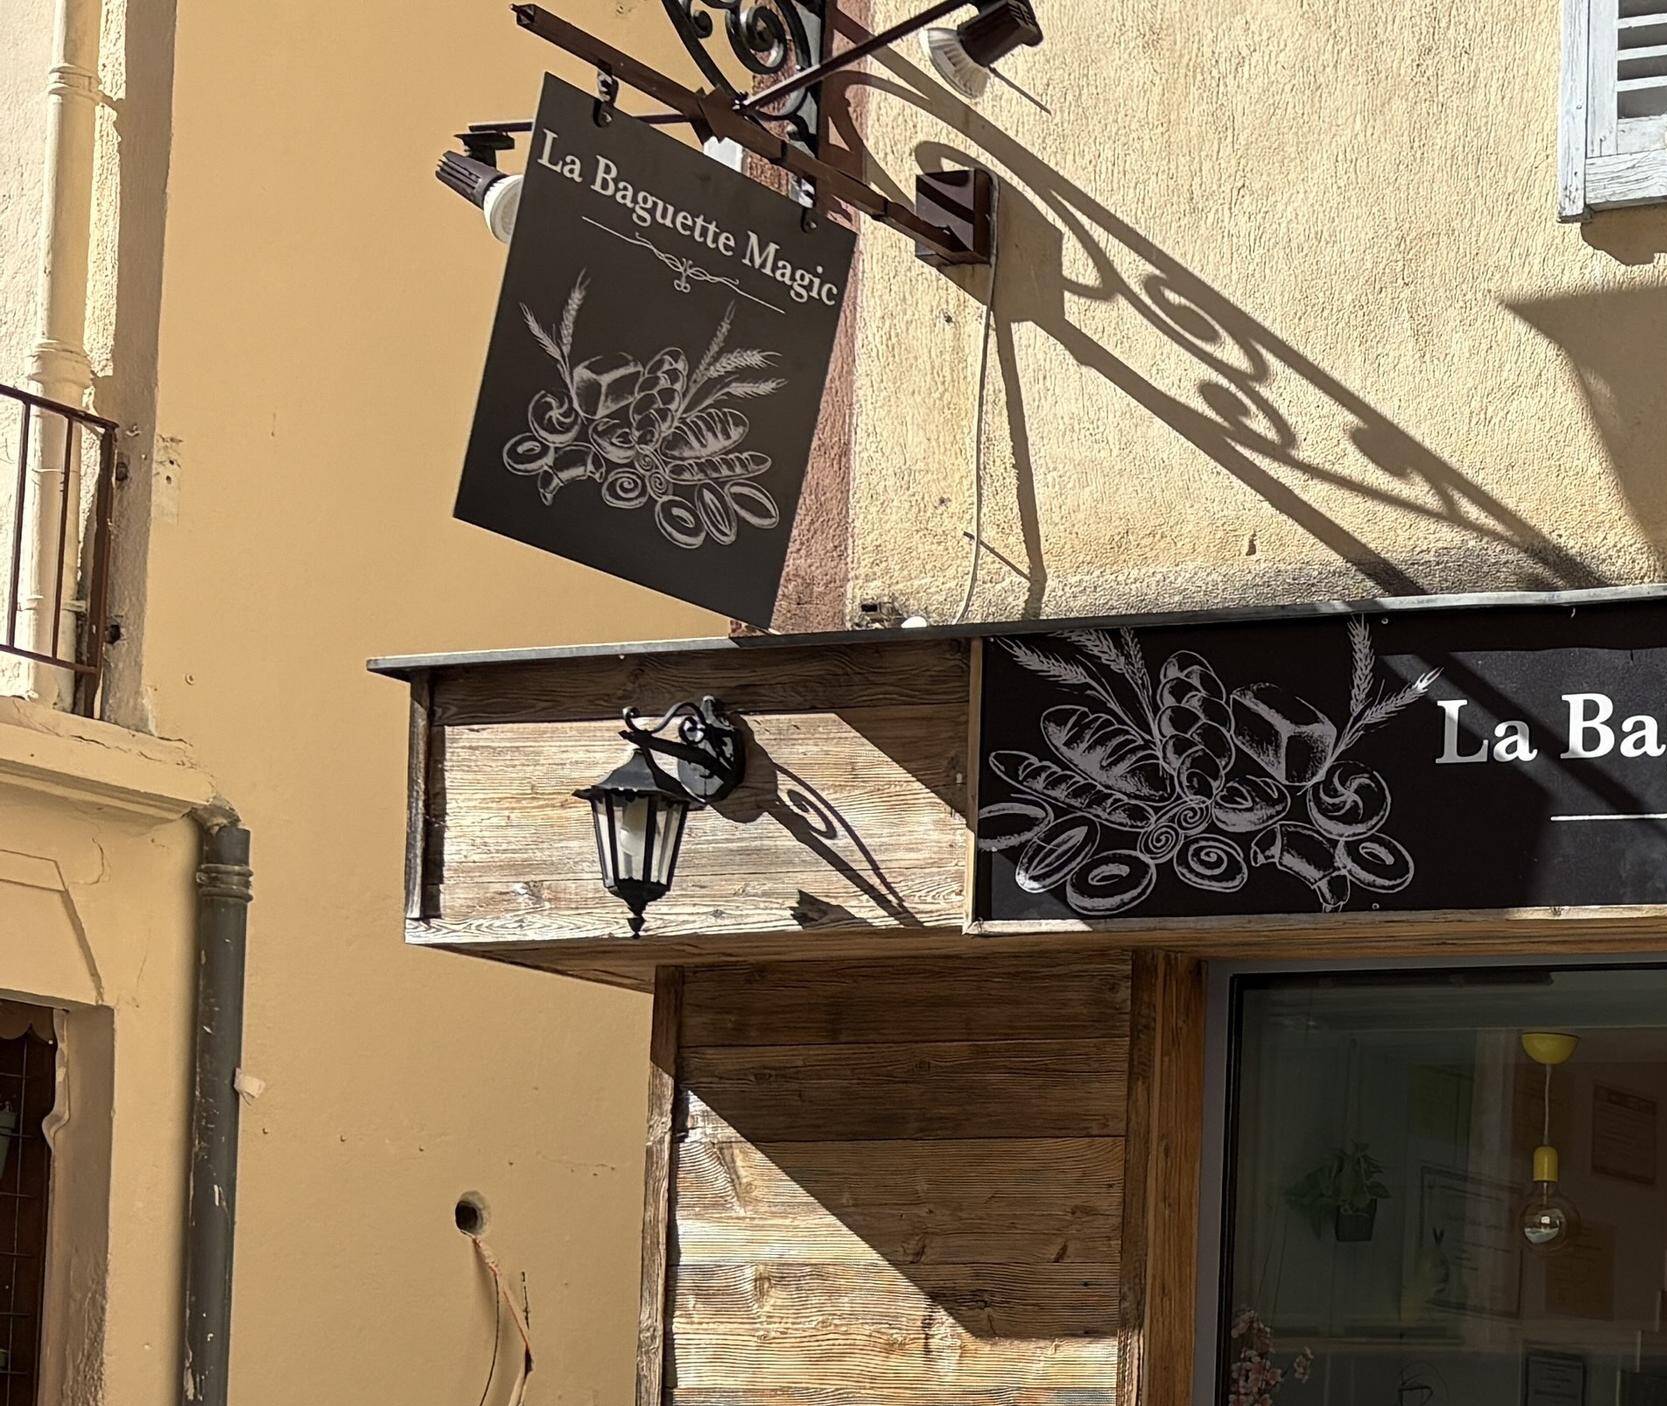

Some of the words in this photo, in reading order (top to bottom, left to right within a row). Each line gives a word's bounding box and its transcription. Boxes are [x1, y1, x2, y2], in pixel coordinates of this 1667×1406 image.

[537, 128, 583, 183] La
[590, 154, 736, 256] Baguette
[741, 230, 839, 306] Magic
[1435, 698, 1538, 764] La
